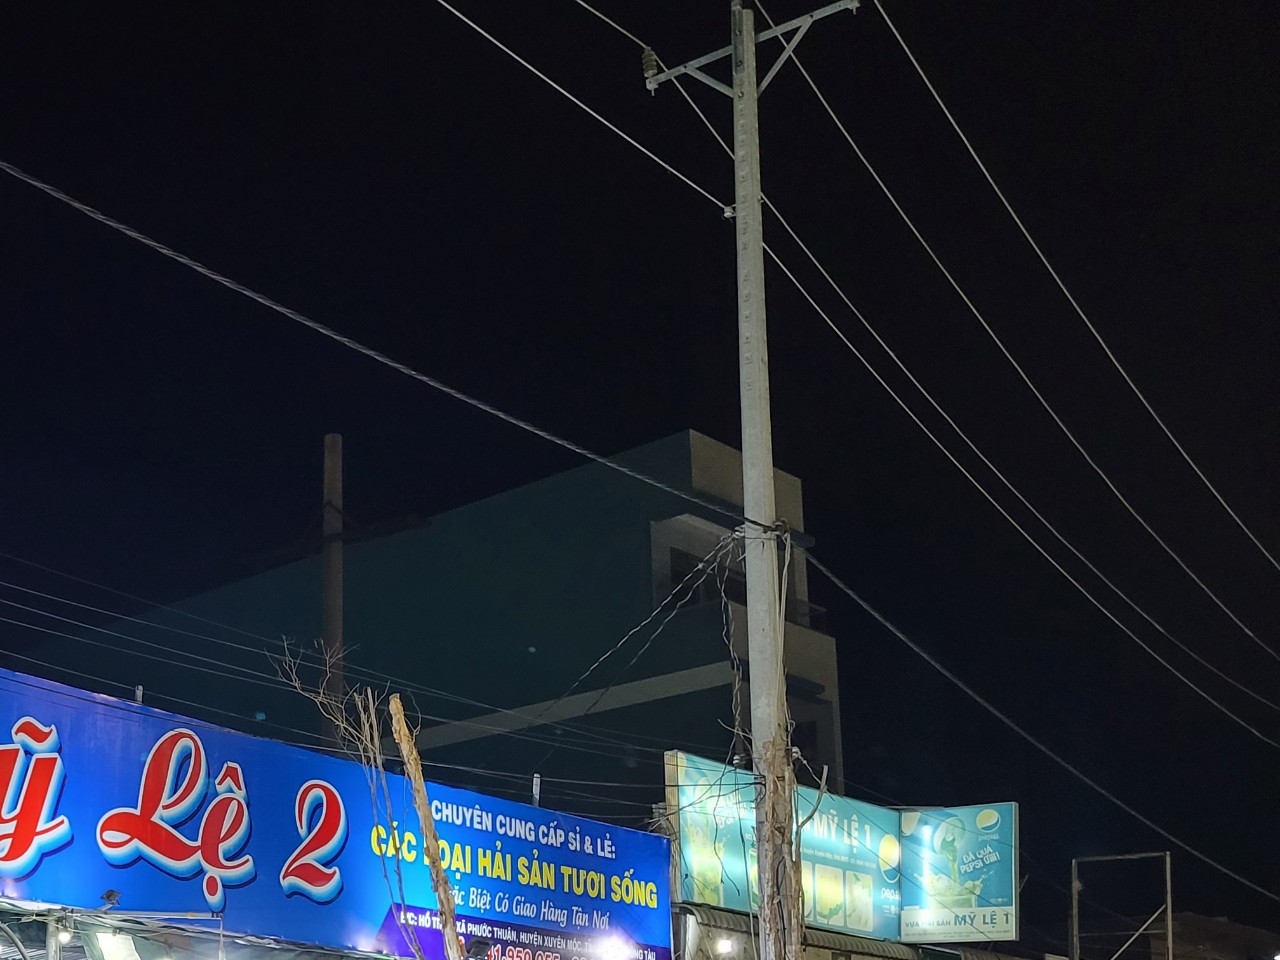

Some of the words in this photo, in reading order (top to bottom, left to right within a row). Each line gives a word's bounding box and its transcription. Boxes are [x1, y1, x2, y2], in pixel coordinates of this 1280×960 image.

[97, 728, 255, 910] Lệ
[280, 779, 347, 902] 2
[431, 799, 493, 832] CHUYÊN
[496, 814, 536, 842] CUNG
[538, 821, 565, 848] CẤP
[568, 826, 581, 851] SỈ
[584, 836, 594, 854] &
[597, 833, 616, 859] LẺ:
[371, 821, 417, 862] CÁC
[478, 840, 511, 881] HẢI
[517, 849, 555, 890] SẢN
[560, 865, 606, 900] TƯƠI
[611, 869, 658, 908] SỐNG
[469, 887, 491, 913] Biệt
[495, 892, 509, 912] Có
[513, 896, 536, 918] Giao
[540, 900, 568, 927] Hàng
[572, 906, 589, 930] Tận
[592, 910, 610, 929] Nơi
[953, 911, 976, 926] MỸ
[982, 911, 997, 928] LỆ
[1003, 913, 1009, 925] 1
[456, 919, 466, 934] XÃ
[467, 922, 492, 938] PHƯỚC
[493, 927, 518, 944] THUẬN,
[520, 931, 542, 947] HUYỆN
[544, 933, 566, 950] XUYÊN
